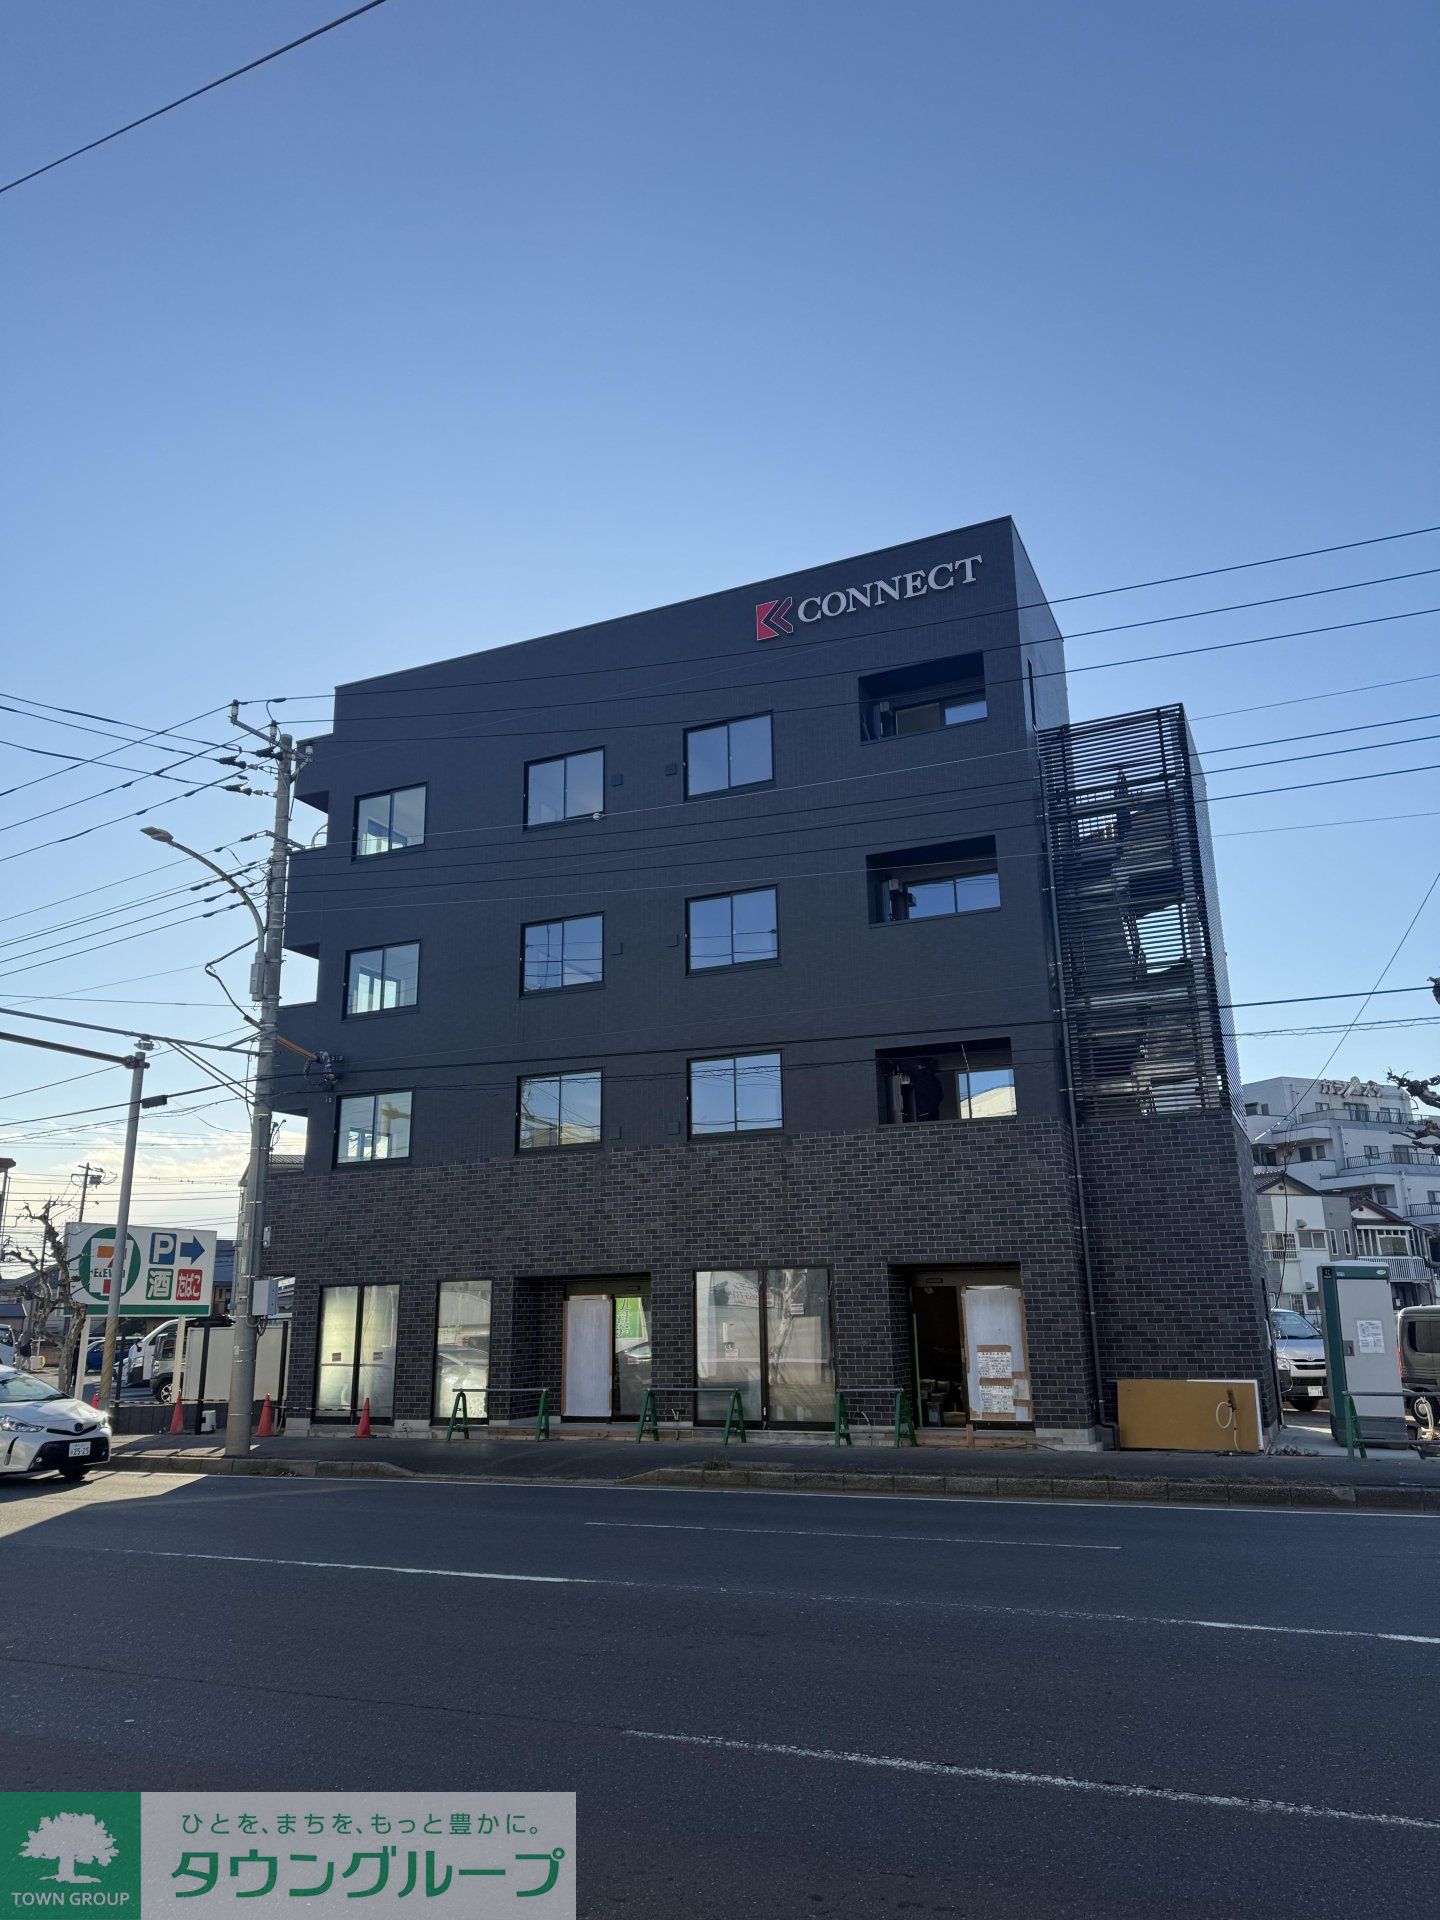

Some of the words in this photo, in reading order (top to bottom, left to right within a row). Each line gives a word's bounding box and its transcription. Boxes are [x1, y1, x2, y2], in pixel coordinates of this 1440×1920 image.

[798, 555, 983, 623] CONNECT
[153, 1234, 175, 1263] P
[147, 1270, 172, 1298] 酒
[177, 1272, 201, 1298] たばこ
